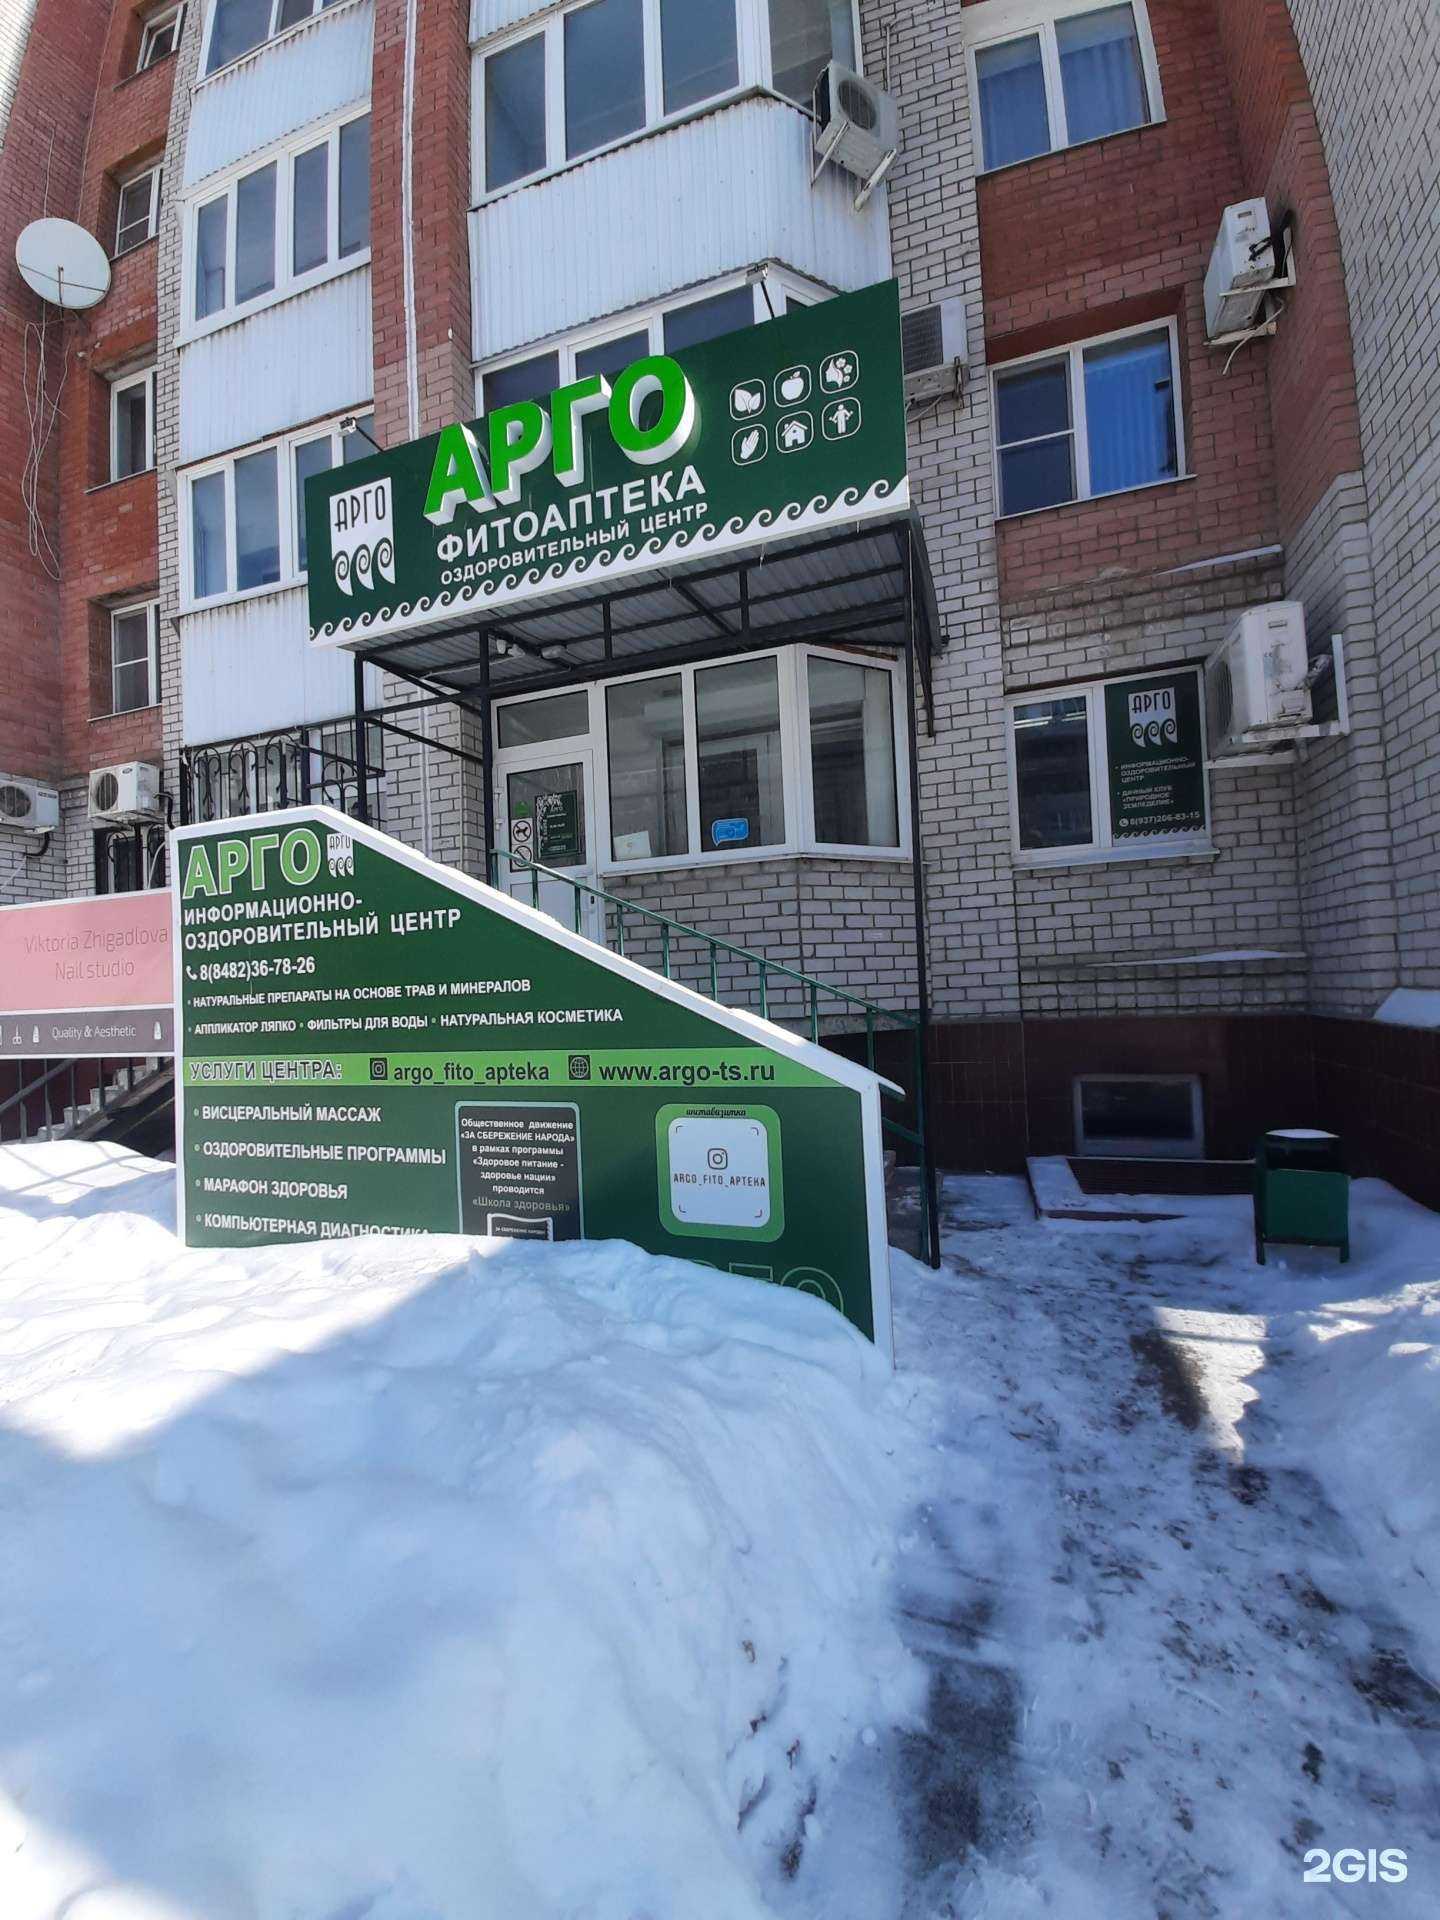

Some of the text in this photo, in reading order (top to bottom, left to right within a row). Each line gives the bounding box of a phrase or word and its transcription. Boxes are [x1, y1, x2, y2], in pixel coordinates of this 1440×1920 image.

[424, 355, 692, 521] АРГО
[336, 486, 387, 533] АРГО
[437, 464, 706, 563] ФИТОАПТЕКА
[440, 502, 709, 586] ОЗДОРОВИТЕЛЬНЫЙ ЦЕНТР
[1132, 690, 1172, 714] АРГО
[182, 828, 321, 899] АРГО
[184, 891, 362, 925] ИНФОРМАЦИОННО-
[24, 926, 168, 954] Viktoria Zhigadlova
[185, 908, 461, 951] ОЗДОРОВИТЕЛЬНЫЙ ЦЕНТР
[55, 959, 135, 981] Nail studio
[199, 956, 315, 983] 8(8482)36-78-26
[193, 979, 531, 1008] НАТУРАЛЬНЫЕ ПРЕПАРАТЫ НА ОСНОВЕ ТРАВ И МИНЕРАЛОВ
[194, 1020, 297, 1035] АППЛИКАТОР ЛЯПКО
[307, 1015, 428, 1031] ФИЛЬТРЫ ДЛЯ ВОДЫ
[440, 1008, 623, 1028] НАТУРАЛЬНАЯ КОСМЕТИКА
[52, 1024, 137, 1040] Quality & Aesthetic
[190, 1058, 343, 1083] УСЛУГИ ЦЕНТРА:
[394, 1062, 549, 1084] argo_fito_apteka
[599, 1061, 775, 1086] www.argo-ts.ru
[202, 1104, 381, 1122] ВИСЦЕРАЛЬНЫЙ МАССАЖ
[461, 1118, 574, 1129] Общественное движение
[461, 1131, 575, 1143] «ЗА СБЕРЕЖЕНИЕ НАРОДА»
[203, 1141, 446, 1165] ОЗДОРОВИТЕЛЬНЫЕ ПРОГРАММЫ
[473, 1157, 520, 1168] «Здоровое
[522, 1160, 558, 1168] питание
[479, 1146, 510, 1154] рамках
[512, 1147, 564, 1156] программы
[480, 1171, 556, 1182] здоровье нации»
[204, 1177, 348, 1200] МАРАФОН ЗДОРОВЬЯ
[492, 1184, 545, 1195] проводится
[472, 1196, 571, 1212] «Школа здоровья»
[204, 1213, 317, 1236] КОМПЬЮТЕРНАЯ
